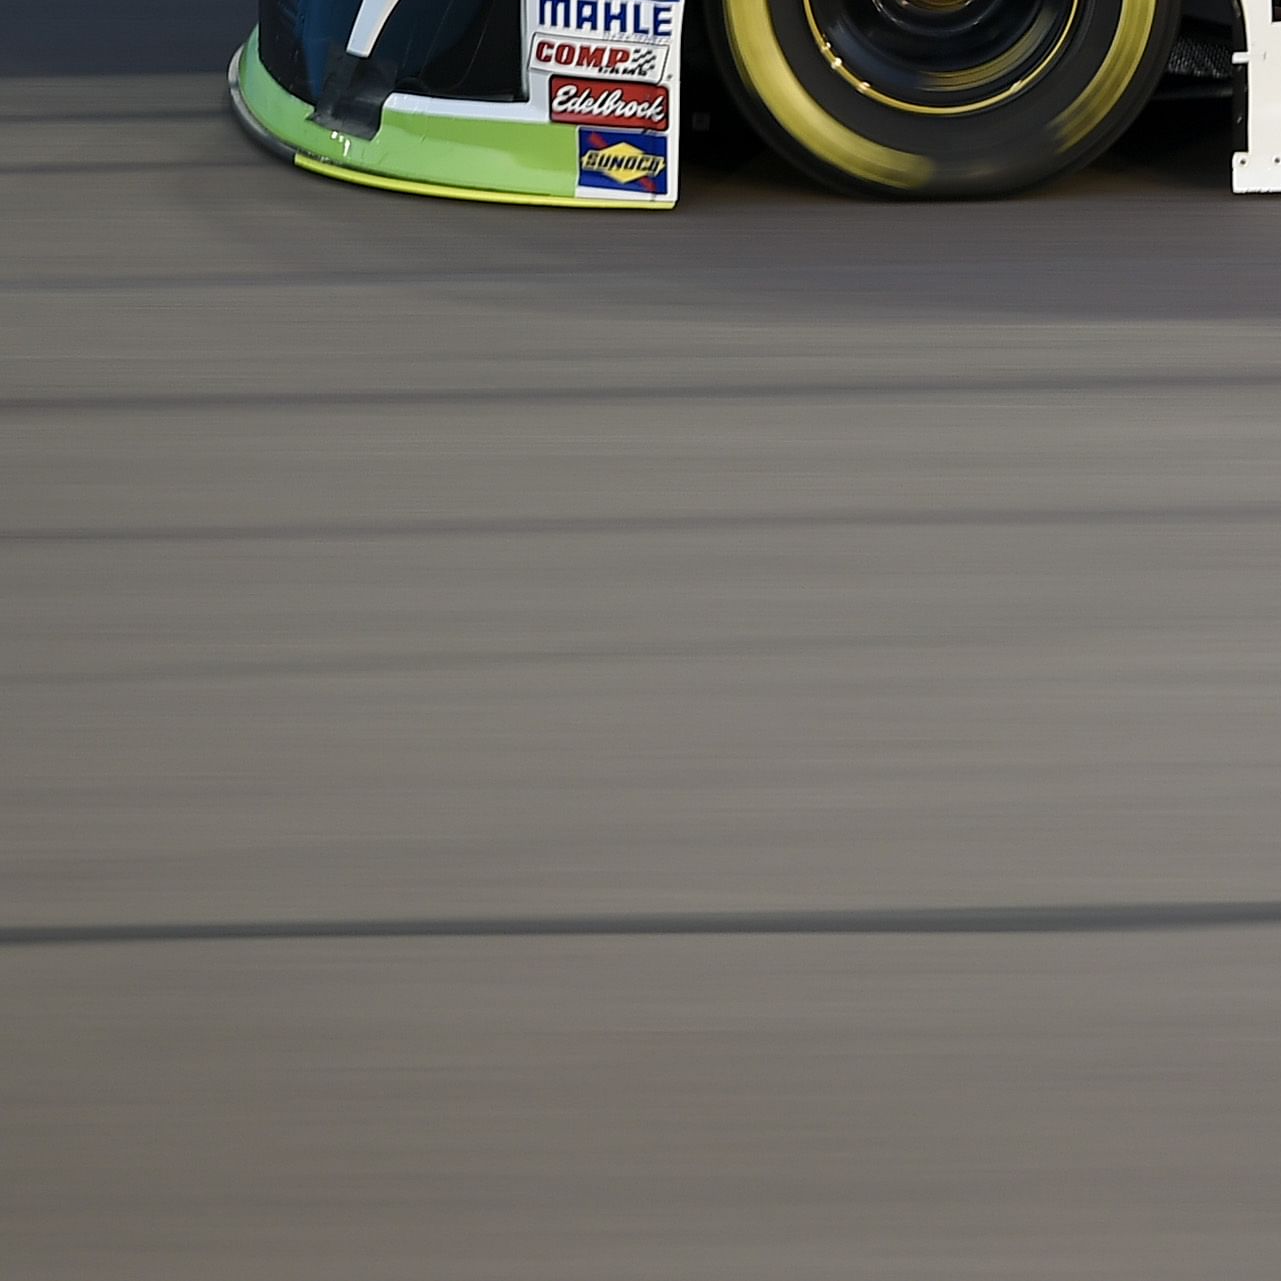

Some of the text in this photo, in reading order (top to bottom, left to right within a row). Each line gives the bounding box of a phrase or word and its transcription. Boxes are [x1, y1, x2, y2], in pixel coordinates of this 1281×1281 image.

[535, 40, 630, 68] COMP
[552, 84, 665, 123] Edelbrock
[584, 150, 661, 176] SUNOCO
